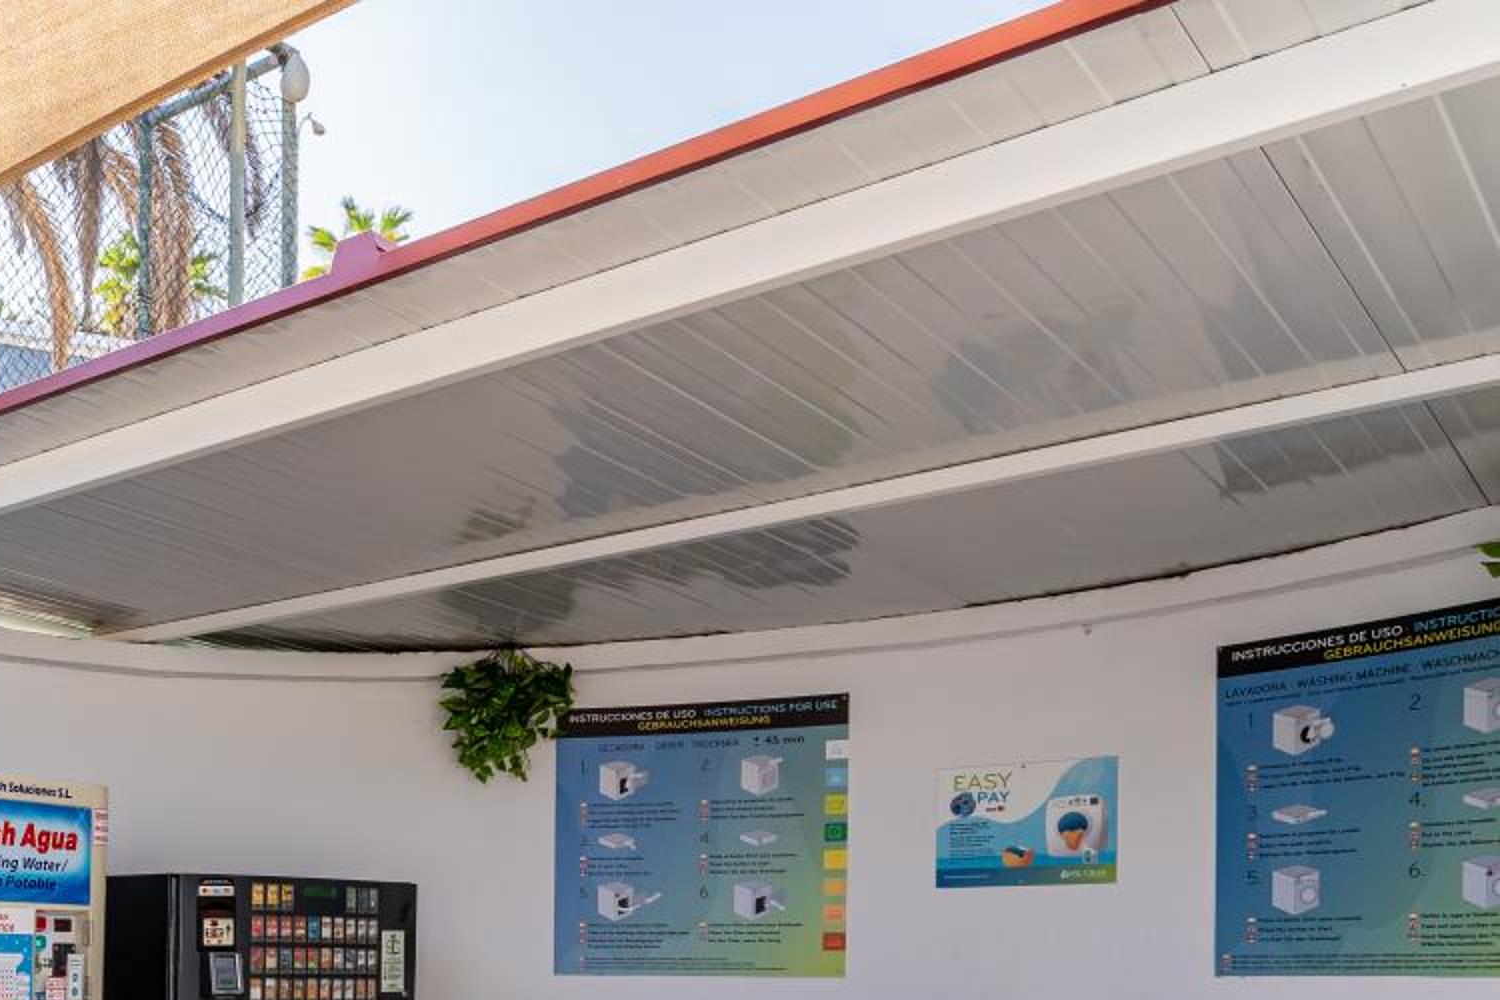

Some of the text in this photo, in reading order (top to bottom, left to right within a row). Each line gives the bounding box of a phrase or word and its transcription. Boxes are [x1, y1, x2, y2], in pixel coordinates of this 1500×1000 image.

[1231, 633, 1345, 663] INSTRUCCIONES
[1349, 629, 1367, 645] DE
[1371, 624, 1403, 641] USO
[673, 709, 697, 720] USO
[953, 771, 1013, 792] EASY
[977, 790, 1011, 804] PAY
[19, 824, 79, 855] Agua
[5, 875, 58, 892] Potable
